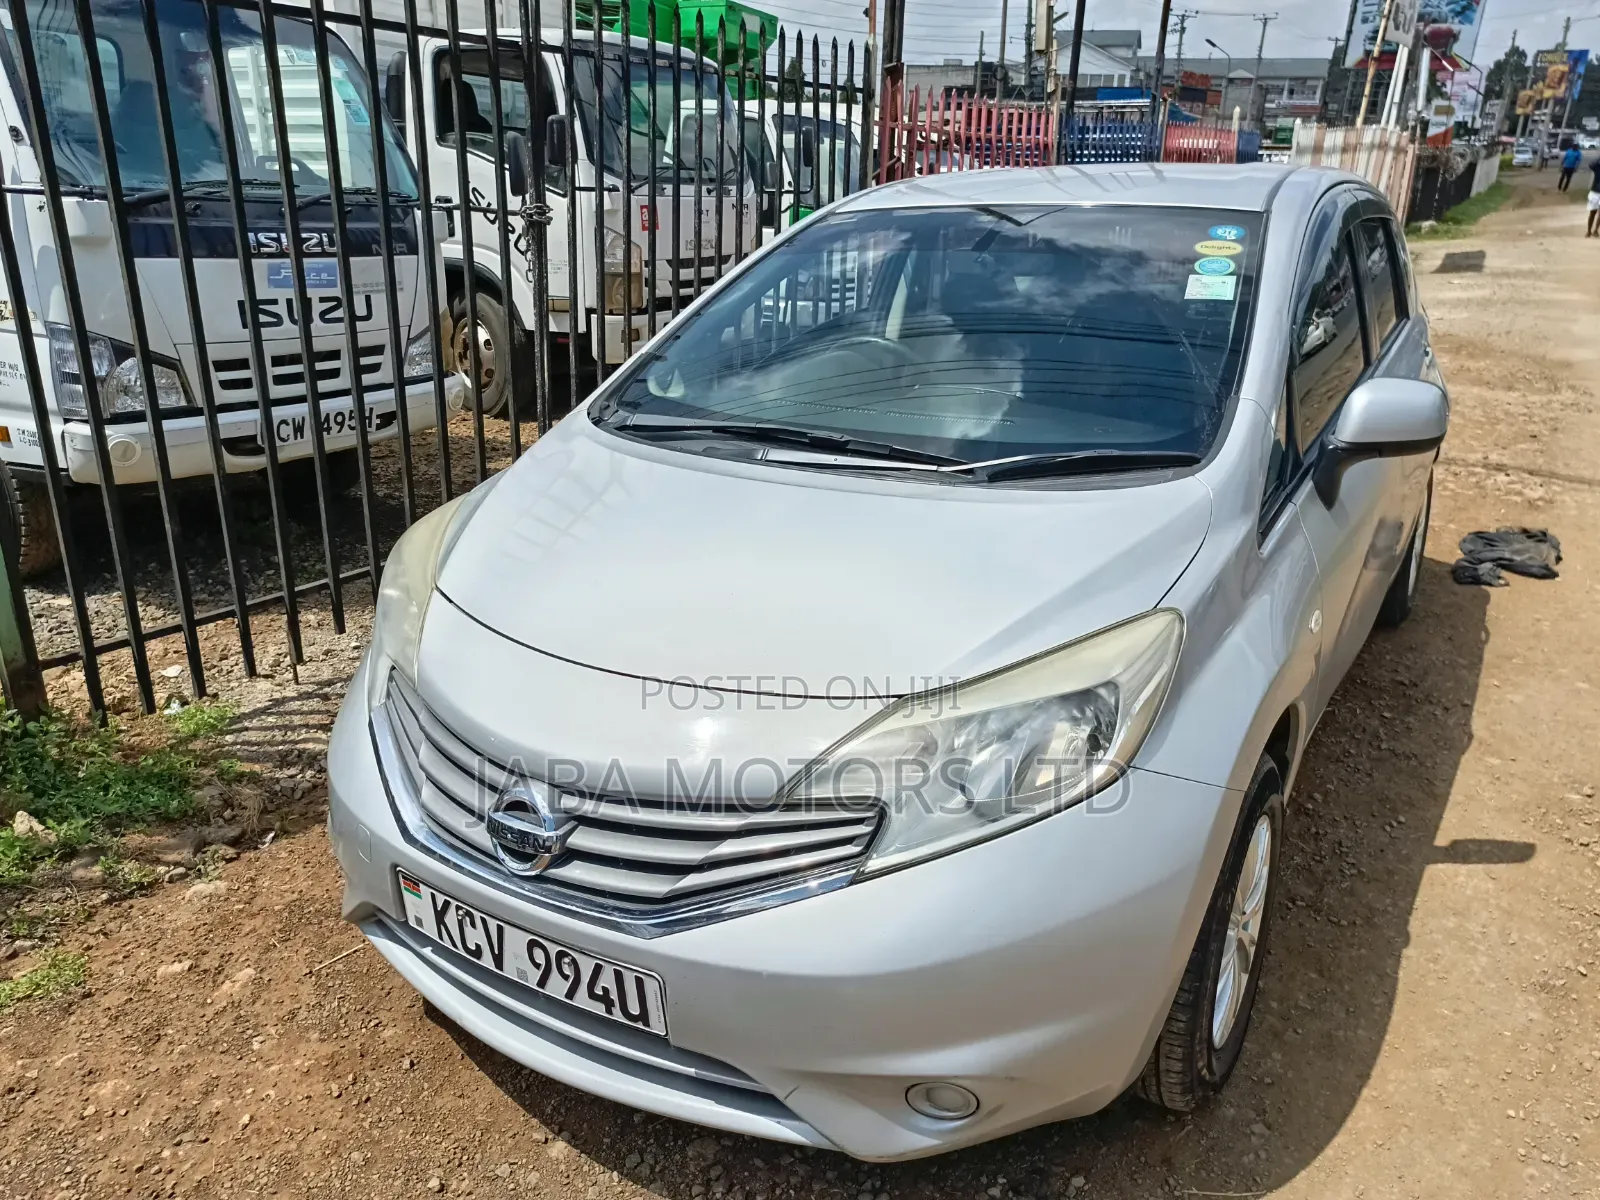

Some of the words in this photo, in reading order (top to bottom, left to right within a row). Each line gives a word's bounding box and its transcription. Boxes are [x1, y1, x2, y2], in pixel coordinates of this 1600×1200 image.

[371, 243, 408, 255] NR
[260, 416, 306, 444] CW
[487, 820, 547, 852] NISSAN
[430, 891, 504, 972] KCV
[526, 938, 651, 1028] 994U
